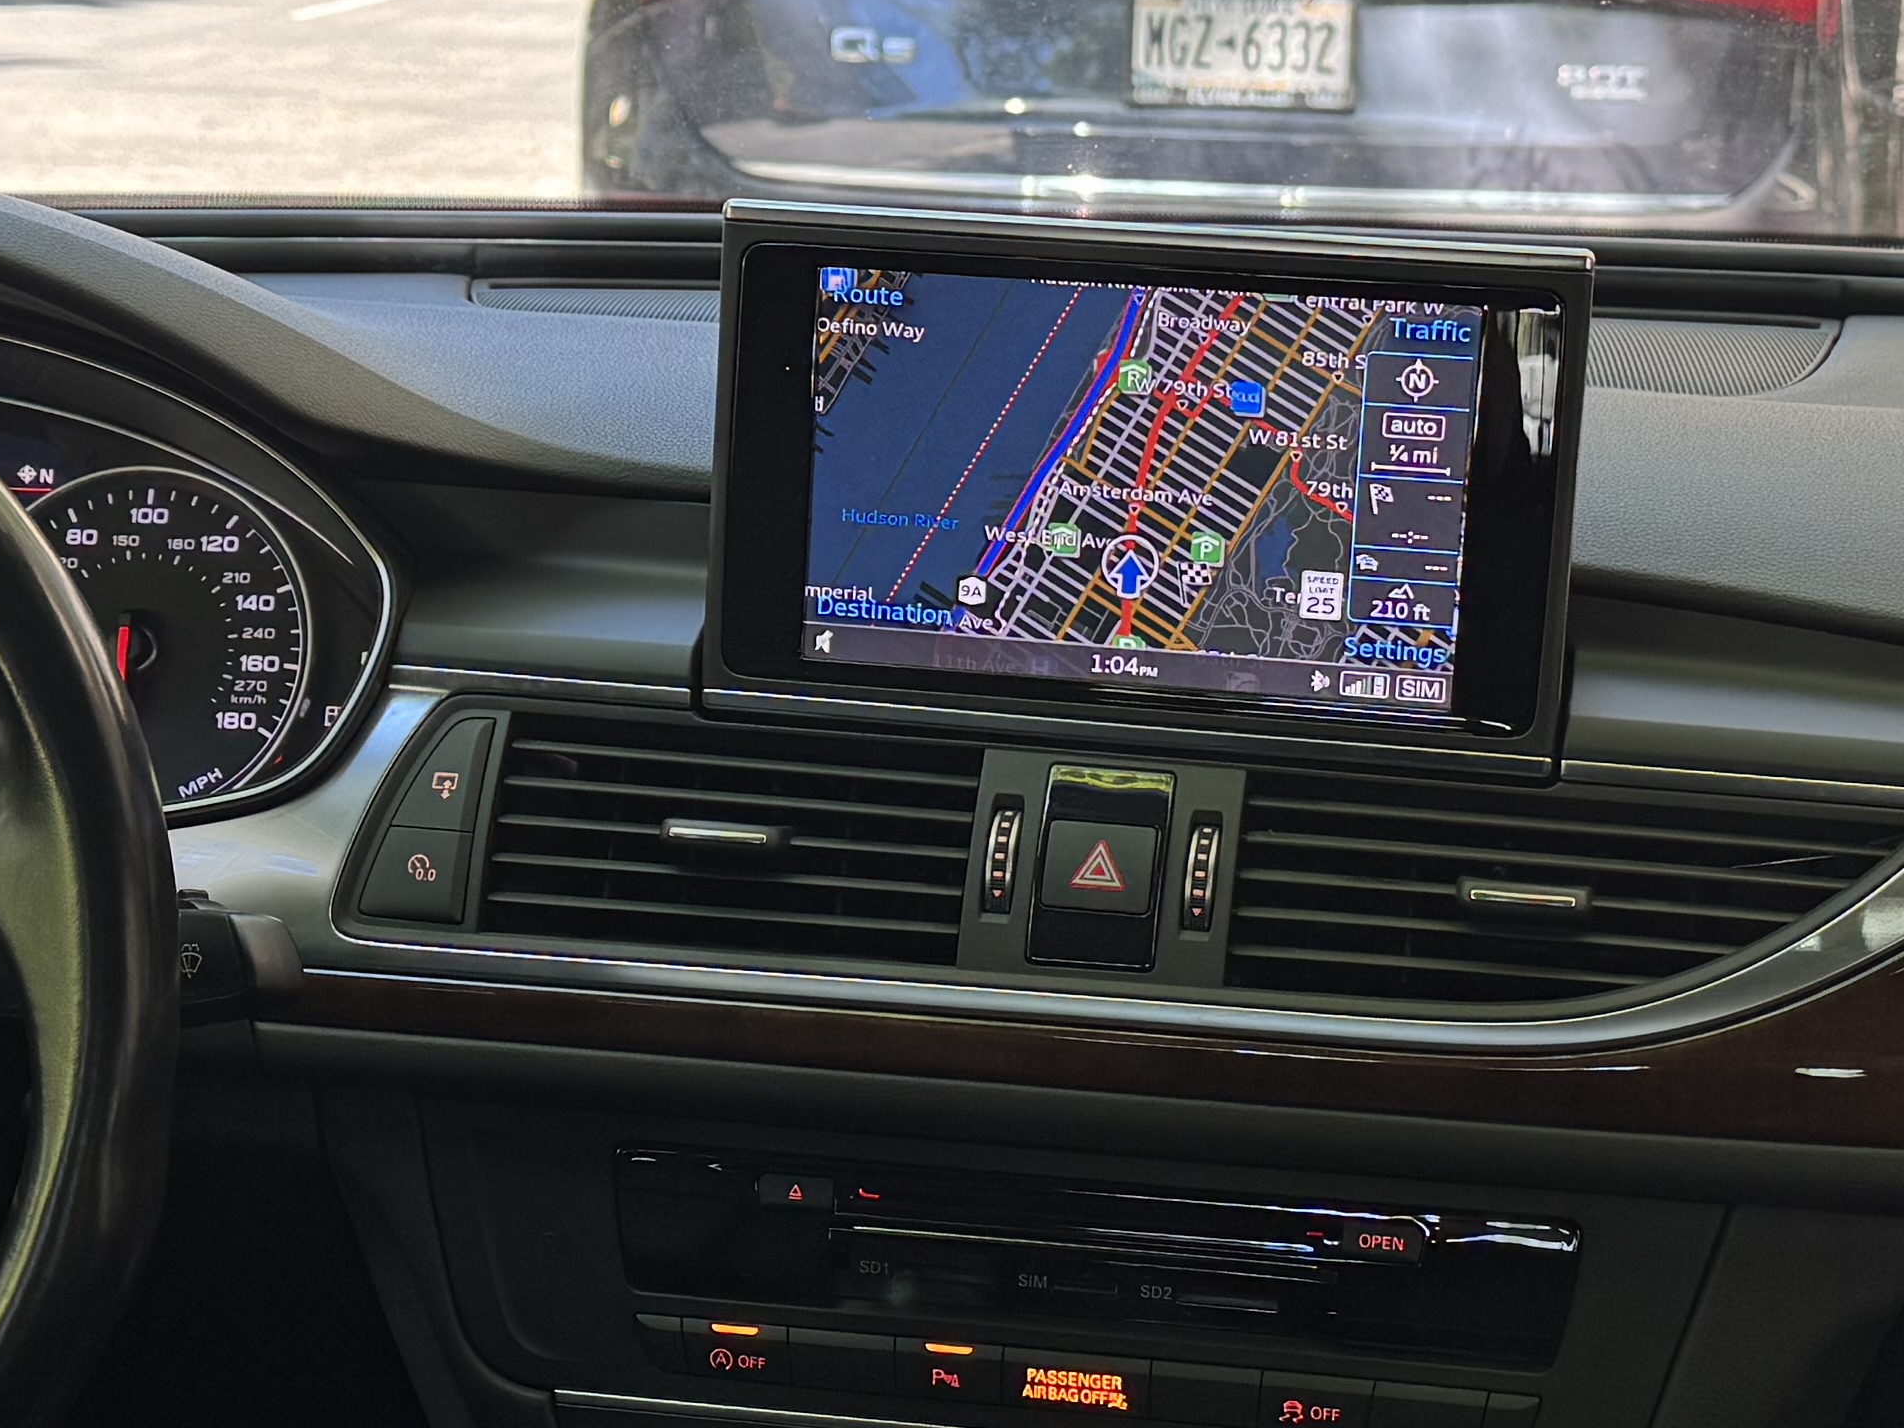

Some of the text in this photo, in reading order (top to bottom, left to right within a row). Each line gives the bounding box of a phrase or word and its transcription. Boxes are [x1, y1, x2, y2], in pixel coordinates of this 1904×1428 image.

[834, 280, 904, 306] Route
[1305, 295, 1366, 311] entral
[882, 321, 925, 343] Way
[1157, 311, 1252, 337] Broadway
[1390, 317, 1472, 343] Traffic
[1301, 351, 1350, 370] 85th
[1161, 380, 1209, 397] 79th
[1390, 418, 1438, 436] auto
[1249, 428, 1348, 451] W 81st St
[1412, 446, 1438, 465] mi
[38, 469, 54, 484] N
[1058, 482, 1214, 507] Amsterdam Ave
[1305, 480, 1353, 499] 79th
[129, 508, 170, 526] 100
[841, 508, 960, 530] Hudson River
[65, 529, 98, 547] 80
[111, 534, 140, 548] 150
[984, 524, 1036, 545] West
[166, 537, 196, 551] 180
[200, 535, 240, 553] 120
[221, 572, 251, 585] 210
[1306, 575, 1340, 586] SPEED
[959, 584, 983, 599] 9A
[235, 594, 275, 612] 140
[1306, 597, 1336, 614] 25
[1369, 600, 1431, 621] 210 ft
[817, 598, 953, 627] Destination
[959, 615, 994, 631] Ave
[241, 627, 276, 640] 240
[1344, 636, 1447, 669] Settings
[239, 655, 280, 673] 160
[233, 680, 268, 693] 270
[1401, 679, 1440, 699] SIM
[229, 693, 267, 706] km/h
[215, 712, 257, 731] 180
[177, 766, 224, 800] MPH
[1358, 1233, 1405, 1253] OPEN
[859, 1259, 890, 1276] SD1
[1018, 1273, 1049, 1290] SIM
[1140, 1284, 1173, 1301] SD2
[737, 1354, 767, 1370] OFF
[1026, 1368, 1123, 1390] PASSENGER
[1021, 1383, 1109, 1406] AIRBAG OFF
[1310, 1405, 1341, 1422] OFF
